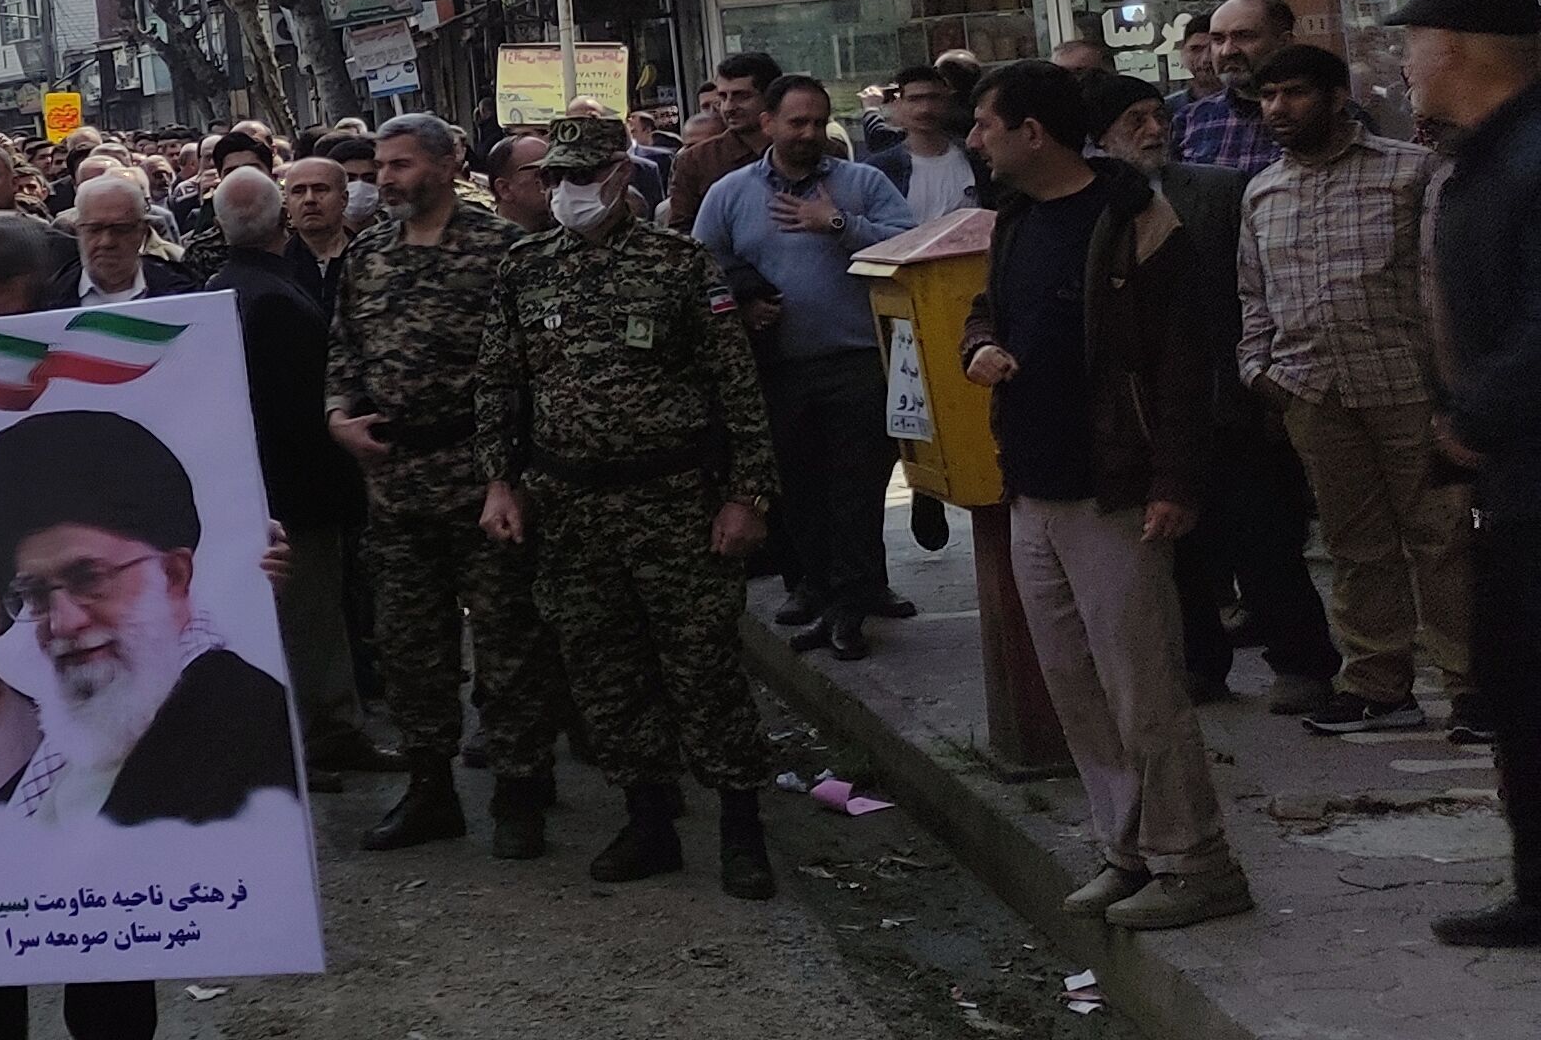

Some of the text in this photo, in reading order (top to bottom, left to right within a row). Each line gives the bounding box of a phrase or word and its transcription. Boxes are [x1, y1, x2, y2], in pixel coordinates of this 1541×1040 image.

[34, 887, 107, 916] مقاومت
[112, 884, 164, 912] ناحیه
[169, 879, 248, 912] فرهنگی
[5, 920, 201, 956] شهرستان صومعه سرا
